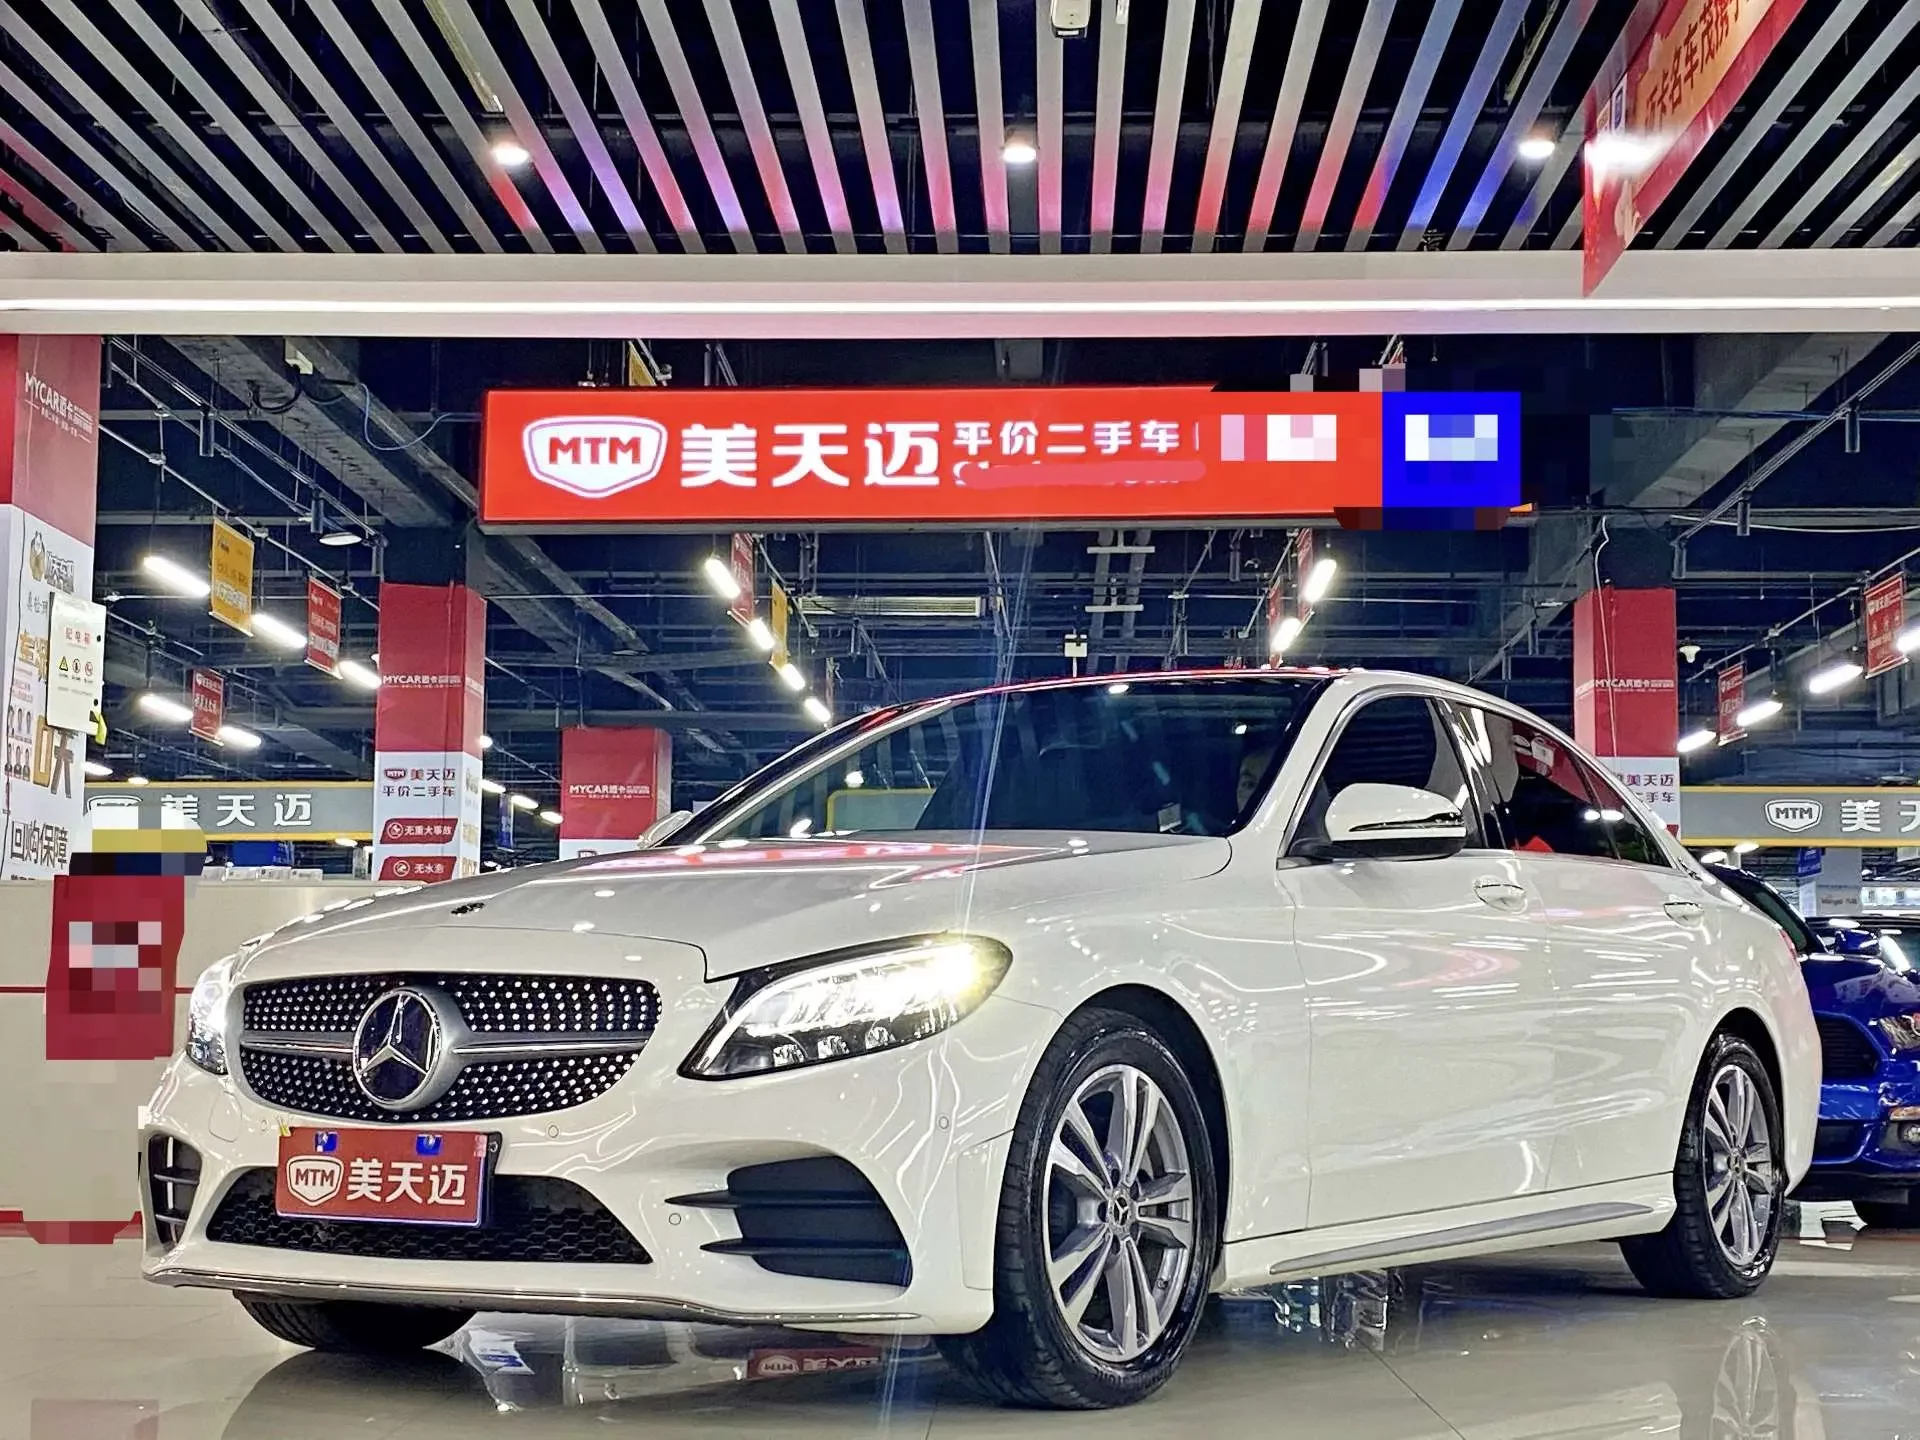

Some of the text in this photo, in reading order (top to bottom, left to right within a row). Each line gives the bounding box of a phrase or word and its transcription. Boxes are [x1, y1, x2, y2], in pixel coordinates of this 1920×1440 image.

[549, 436, 641, 465] MTM
[680, 422, 940, 488] 美天迈
[953, 420, 1180, 455] 平价二手车
[410, 768, 456, 781] 美天迈
[1626, 774, 1674, 786] 美天迈
[383, 785, 455, 797] 平价二手车
[1775, 807, 1813, 819] MTM
[294, 1157, 468, 1206] MTM 美天迈
